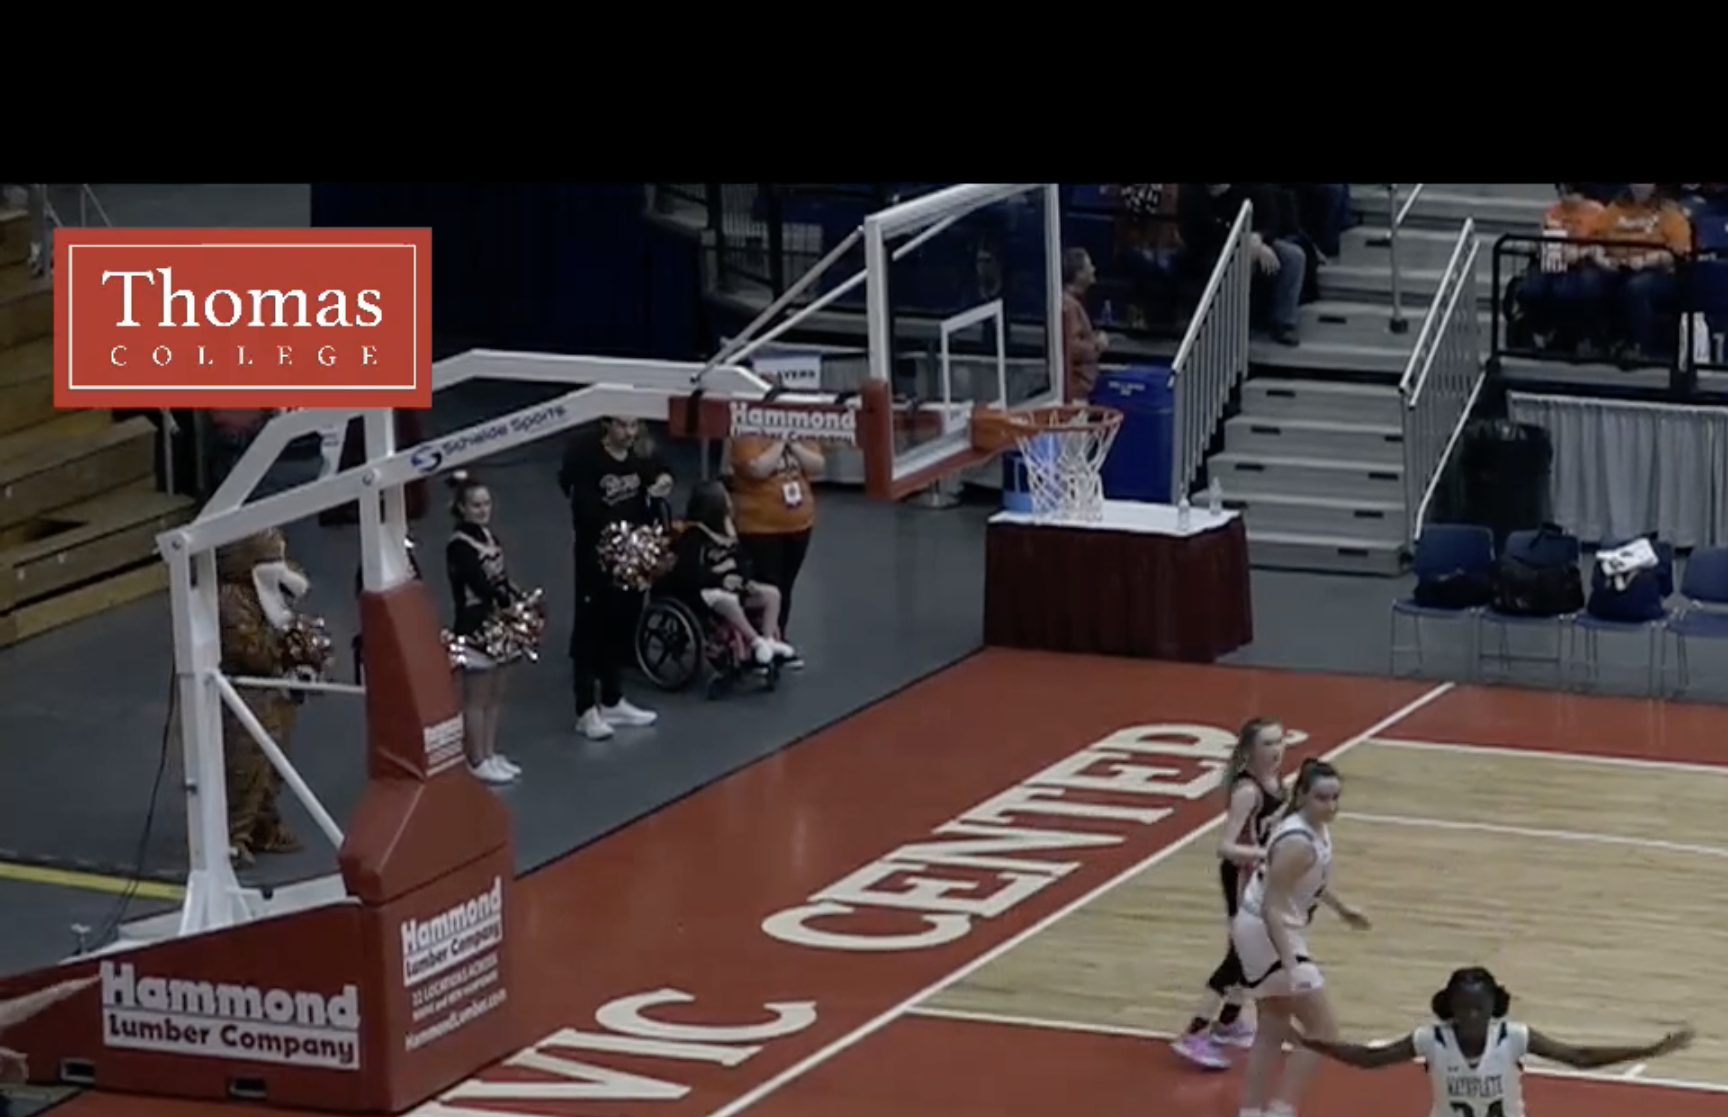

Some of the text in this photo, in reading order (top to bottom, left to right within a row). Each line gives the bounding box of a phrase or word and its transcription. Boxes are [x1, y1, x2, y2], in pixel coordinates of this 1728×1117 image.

[509, 404, 567, 434] Sports
[729, 401, 857, 431] Hammond
[401, 876, 502, 953] Hammond
[405, 922, 500, 979] Lumber Company
[101, 960, 360, 1029] Hammond
[108, 1013, 355, 1064] Lumber Company
